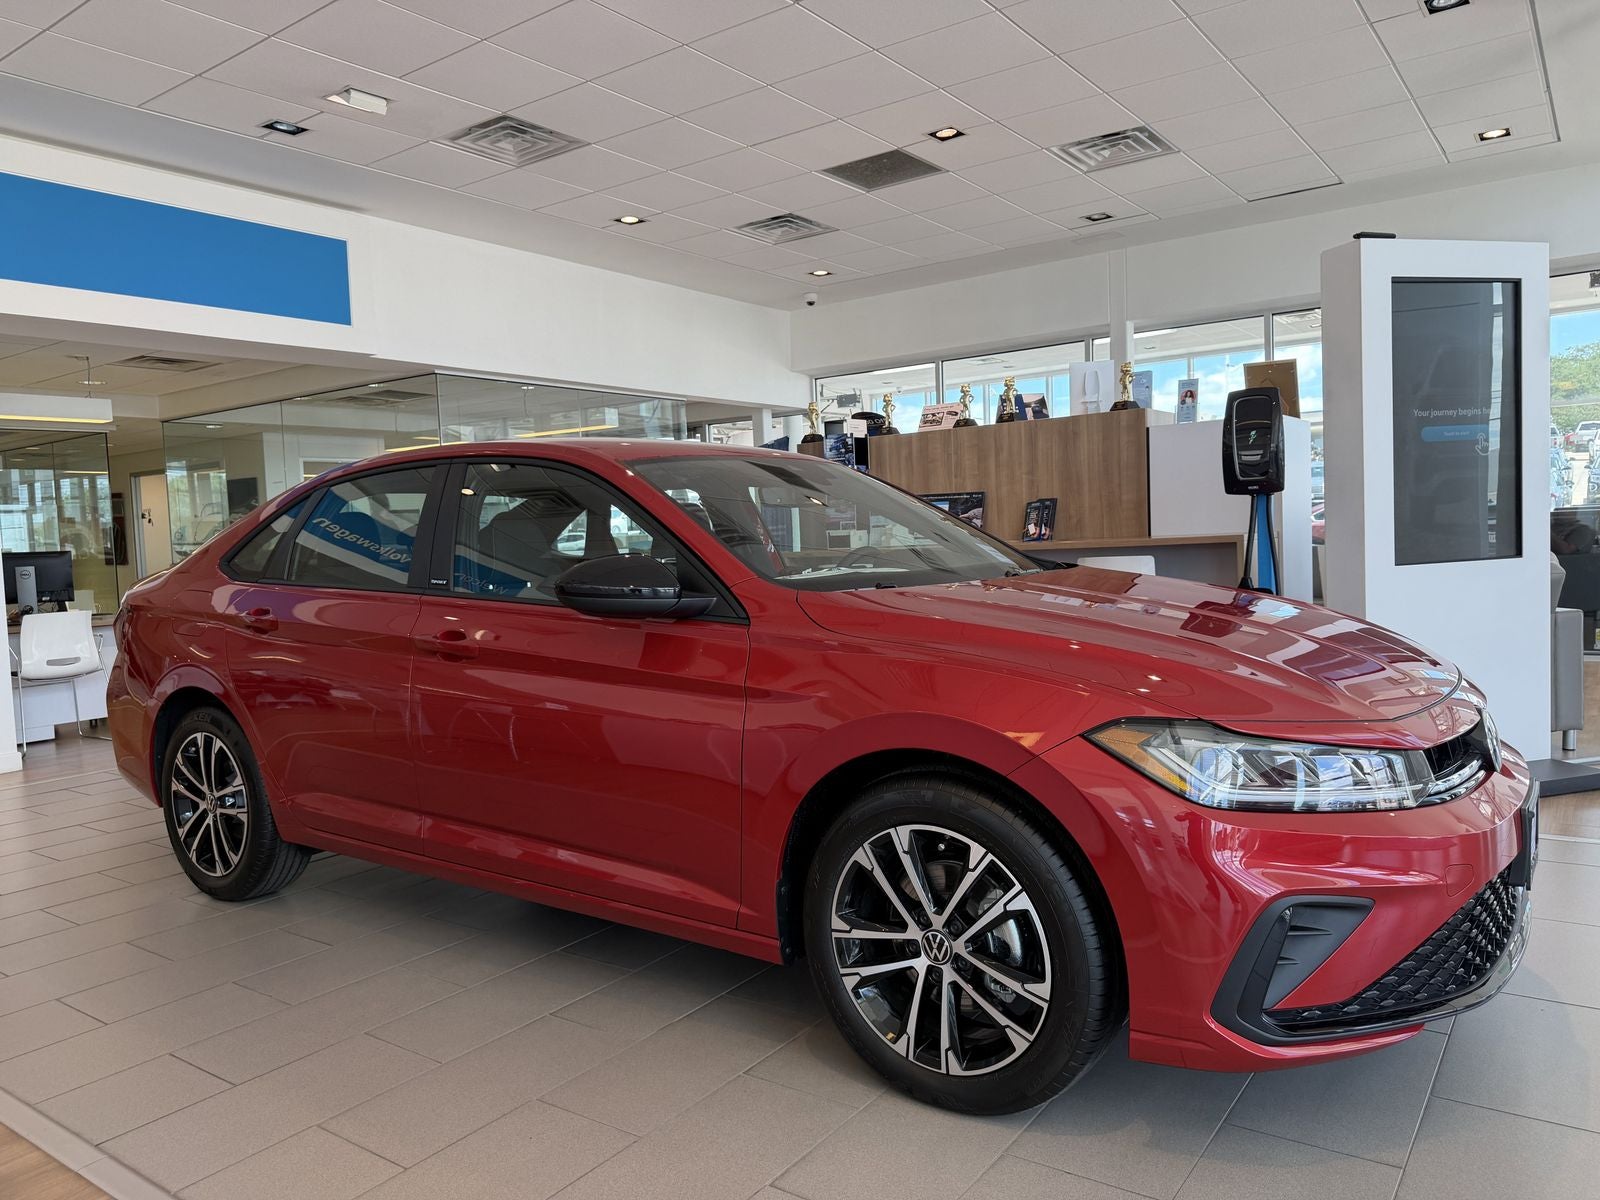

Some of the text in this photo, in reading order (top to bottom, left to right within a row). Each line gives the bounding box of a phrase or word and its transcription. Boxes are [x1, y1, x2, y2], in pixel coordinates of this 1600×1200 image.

[1413, 409, 1430, 417] Your
[1430, 408, 1458, 418] journey
[1458, 407, 1482, 416] begins
[922, 930, 951, 964] VW
